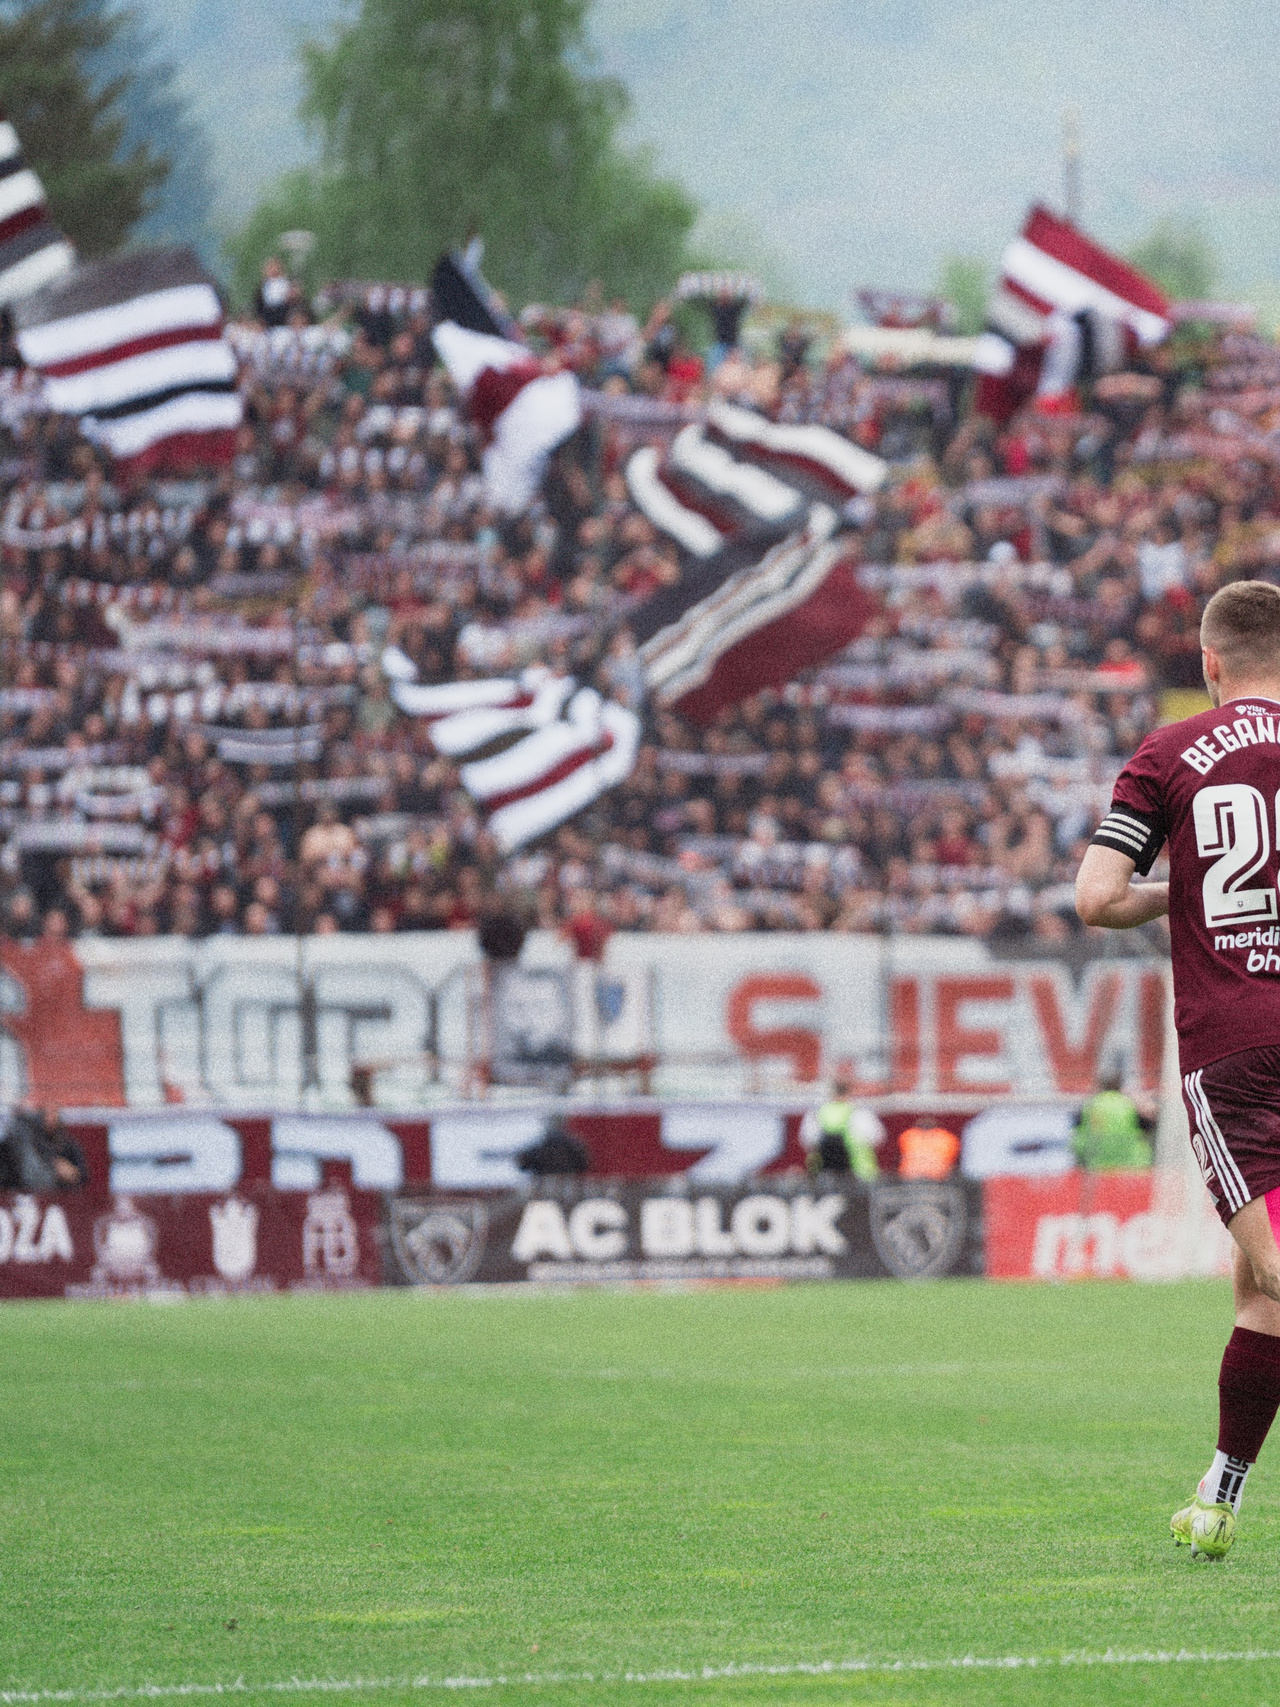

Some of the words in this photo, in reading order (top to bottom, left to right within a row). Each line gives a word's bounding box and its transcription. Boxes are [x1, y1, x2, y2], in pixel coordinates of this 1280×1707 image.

[1246, 704, 1267, 714] VISIT
[1247, 948, 1280, 972] bh
[511, 1198, 630, 1263] AC
[639, 1193, 848, 1256] BLOK
